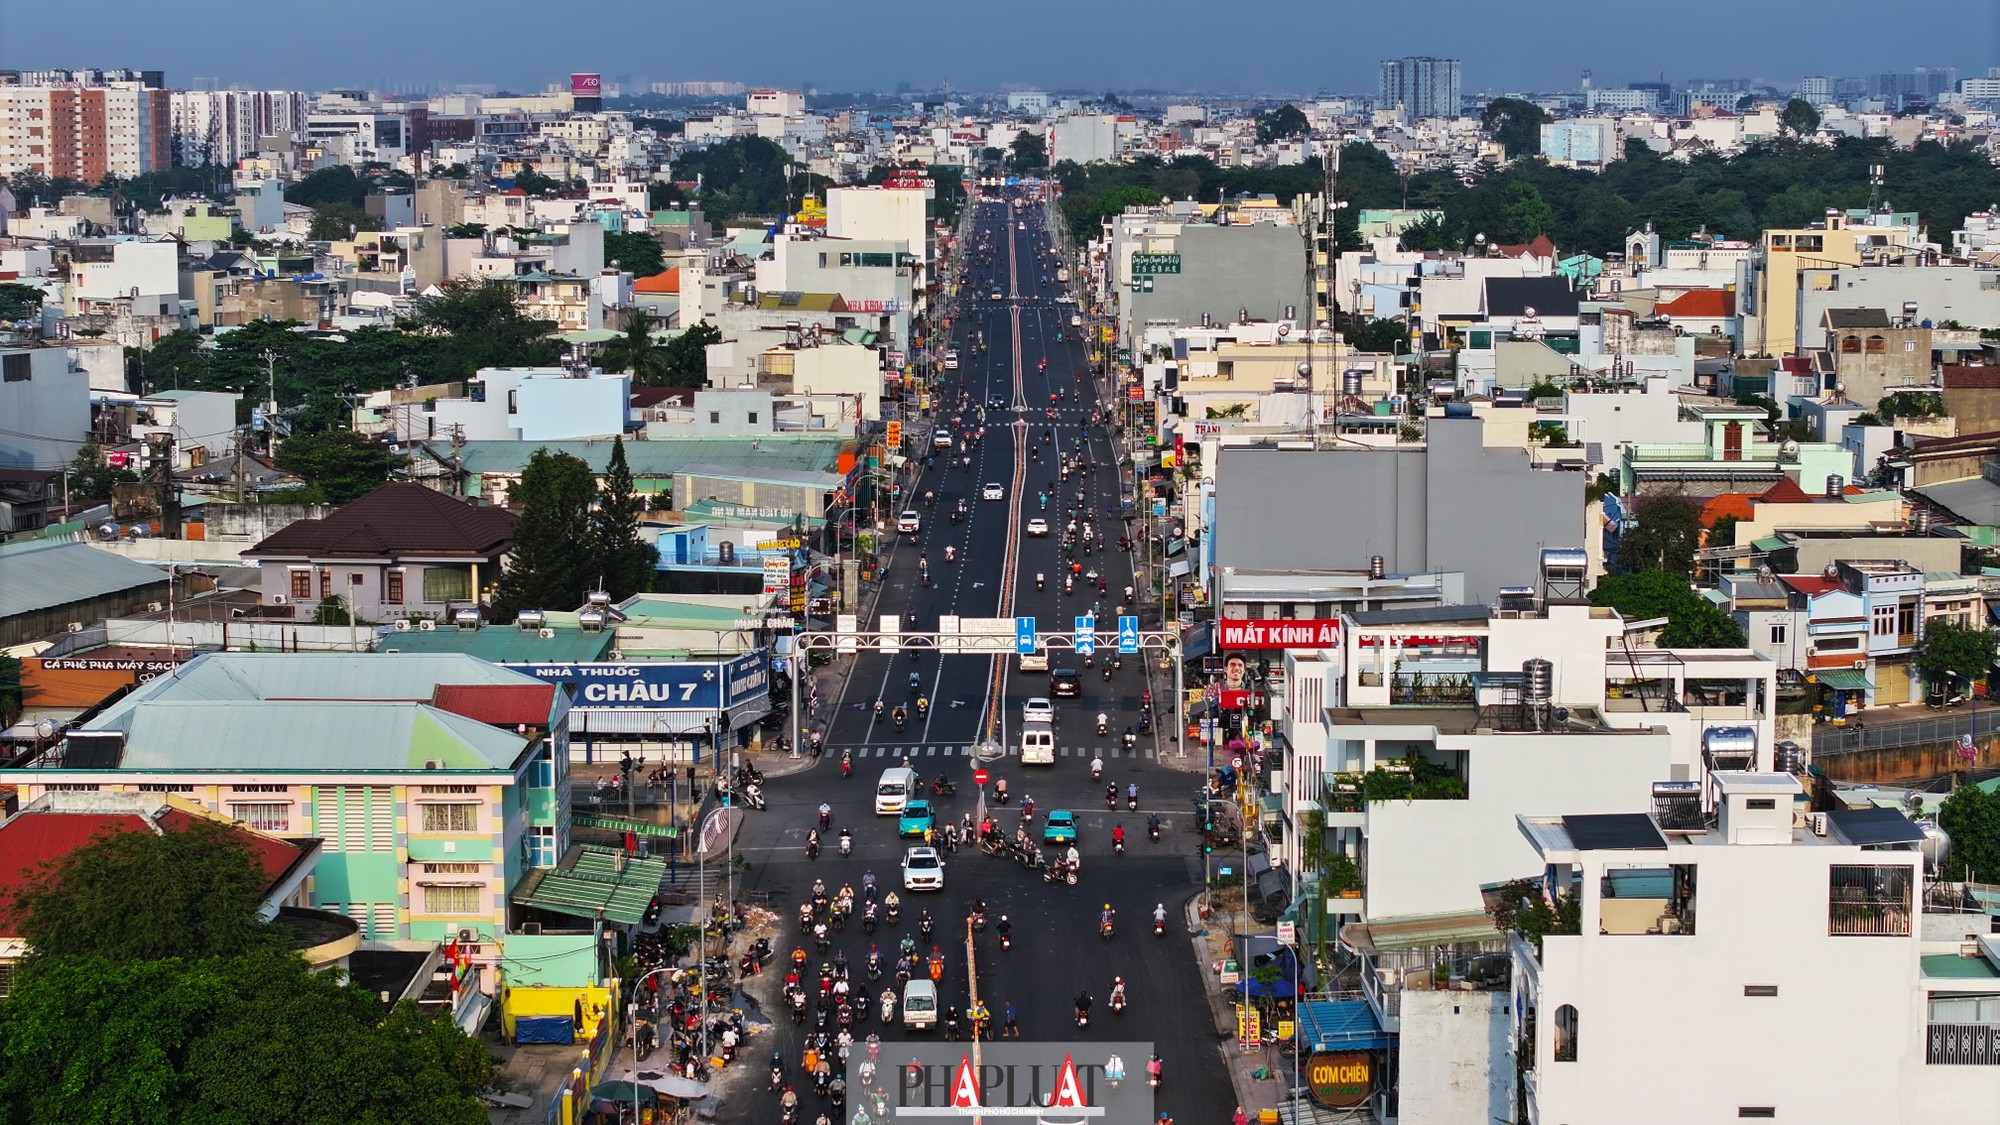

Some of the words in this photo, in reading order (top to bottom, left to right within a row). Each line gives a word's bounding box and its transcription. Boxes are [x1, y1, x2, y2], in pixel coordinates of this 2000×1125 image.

[735, 619, 763, 629] MINH
[766, 616, 795, 628] CHÂU
[1225, 622, 1266, 644] MẮT
[1268, 624, 1314, 643] KÍNH
[62, 659, 87, 670] PHÊ
[88, 661, 114, 670] PHA
[116, 660, 145, 670] MÁY
[536, 665, 573, 677] NHÀ
[578, 664, 640, 677] THUỐC
[584, 680, 670, 702] CHÂU
[679, 683, 698, 701] 7
[1313, 1065, 1338, 1084] CƠM
[1340, 1062, 1369, 1084] CHIÊN
